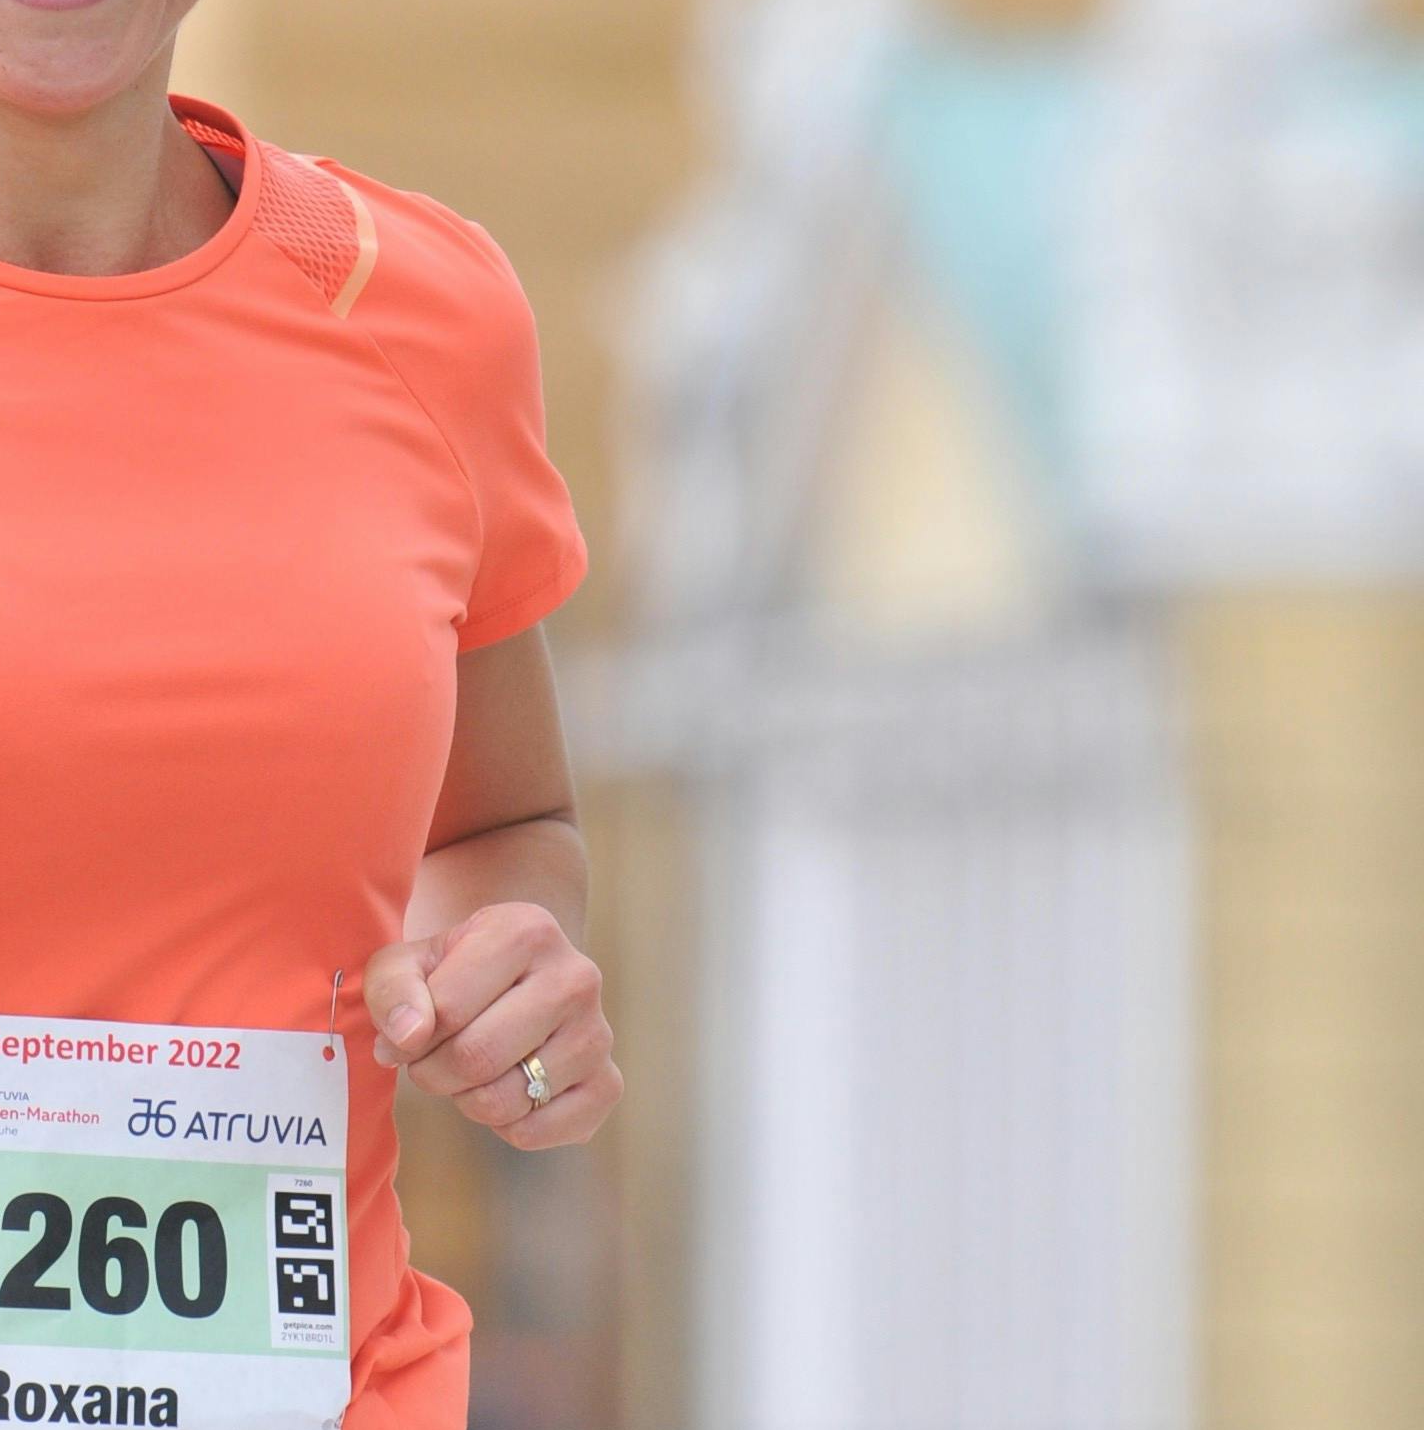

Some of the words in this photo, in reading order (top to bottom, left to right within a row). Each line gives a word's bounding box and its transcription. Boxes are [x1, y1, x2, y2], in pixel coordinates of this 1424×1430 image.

[168, 1039, 241, 1070] 2022
[184, 1111, 327, 1146] ATRUVIA
[294, 1178, 313, 1187] 7260
[283, 1322, 333, 1331] getpica.com
